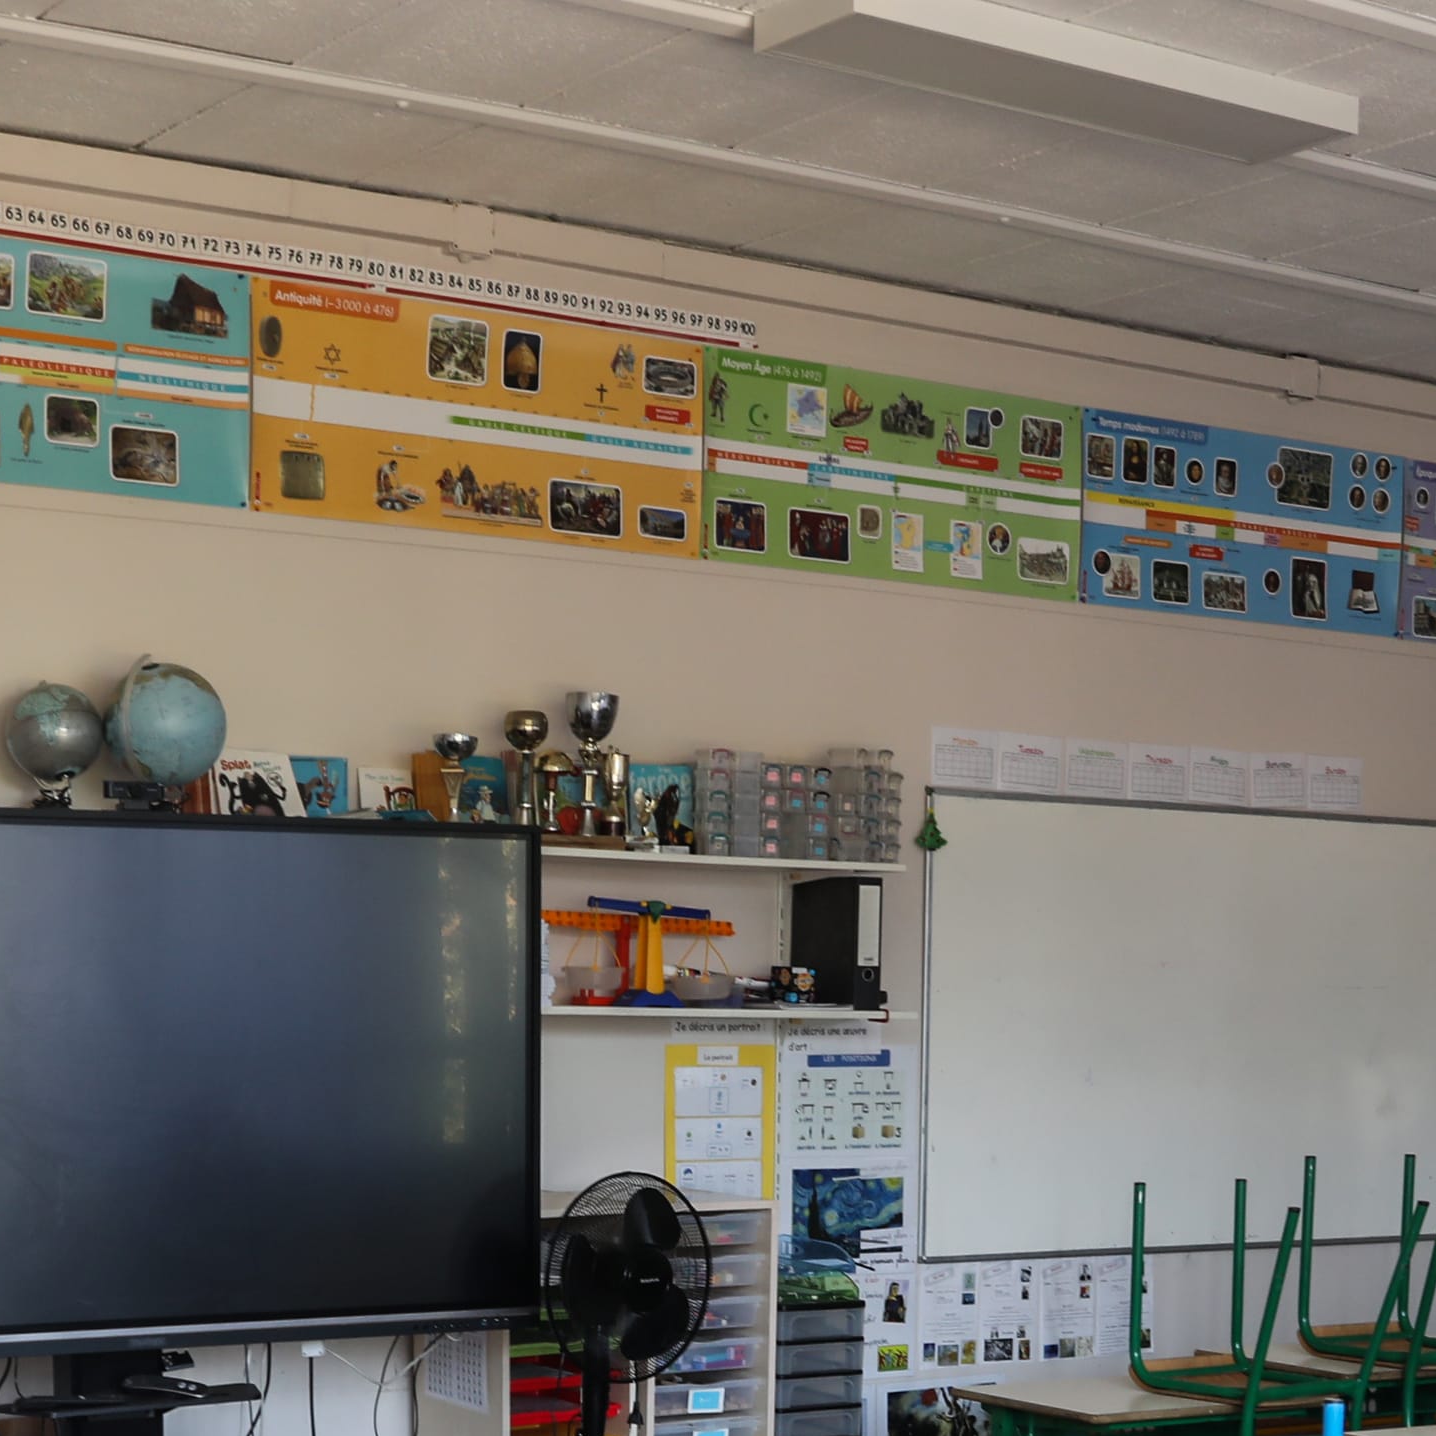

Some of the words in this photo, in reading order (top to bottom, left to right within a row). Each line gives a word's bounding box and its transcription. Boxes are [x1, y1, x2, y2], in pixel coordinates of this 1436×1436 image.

[28, 210, 45, 225] 64
[116, 225, 133, 240] 68
[159, 232, 175, 247] 70
[246, 243, 262, 257] 74
[367, 262, 385, 277] 80
[409, 268, 424, 283] 82
[562, 293, 578, 308] 90
[635, 305, 650, 318] 94
[707, 316, 721, 330] 98
[740, 322, 756, 336] 100
[275, 290, 323, 306] Antiquité
[722, 358, 752, 371] Moyen
[1098, 416, 1122, 429] Temps
[675, 1021, 687, 1032] Je
[688, 1021, 715, 1031] décris
[717, 1023, 727, 1032] un
[728, 1022, 761, 1034] portrait
[799, 1025, 825, 1036] décris
[827, 1027, 841, 1036] une
